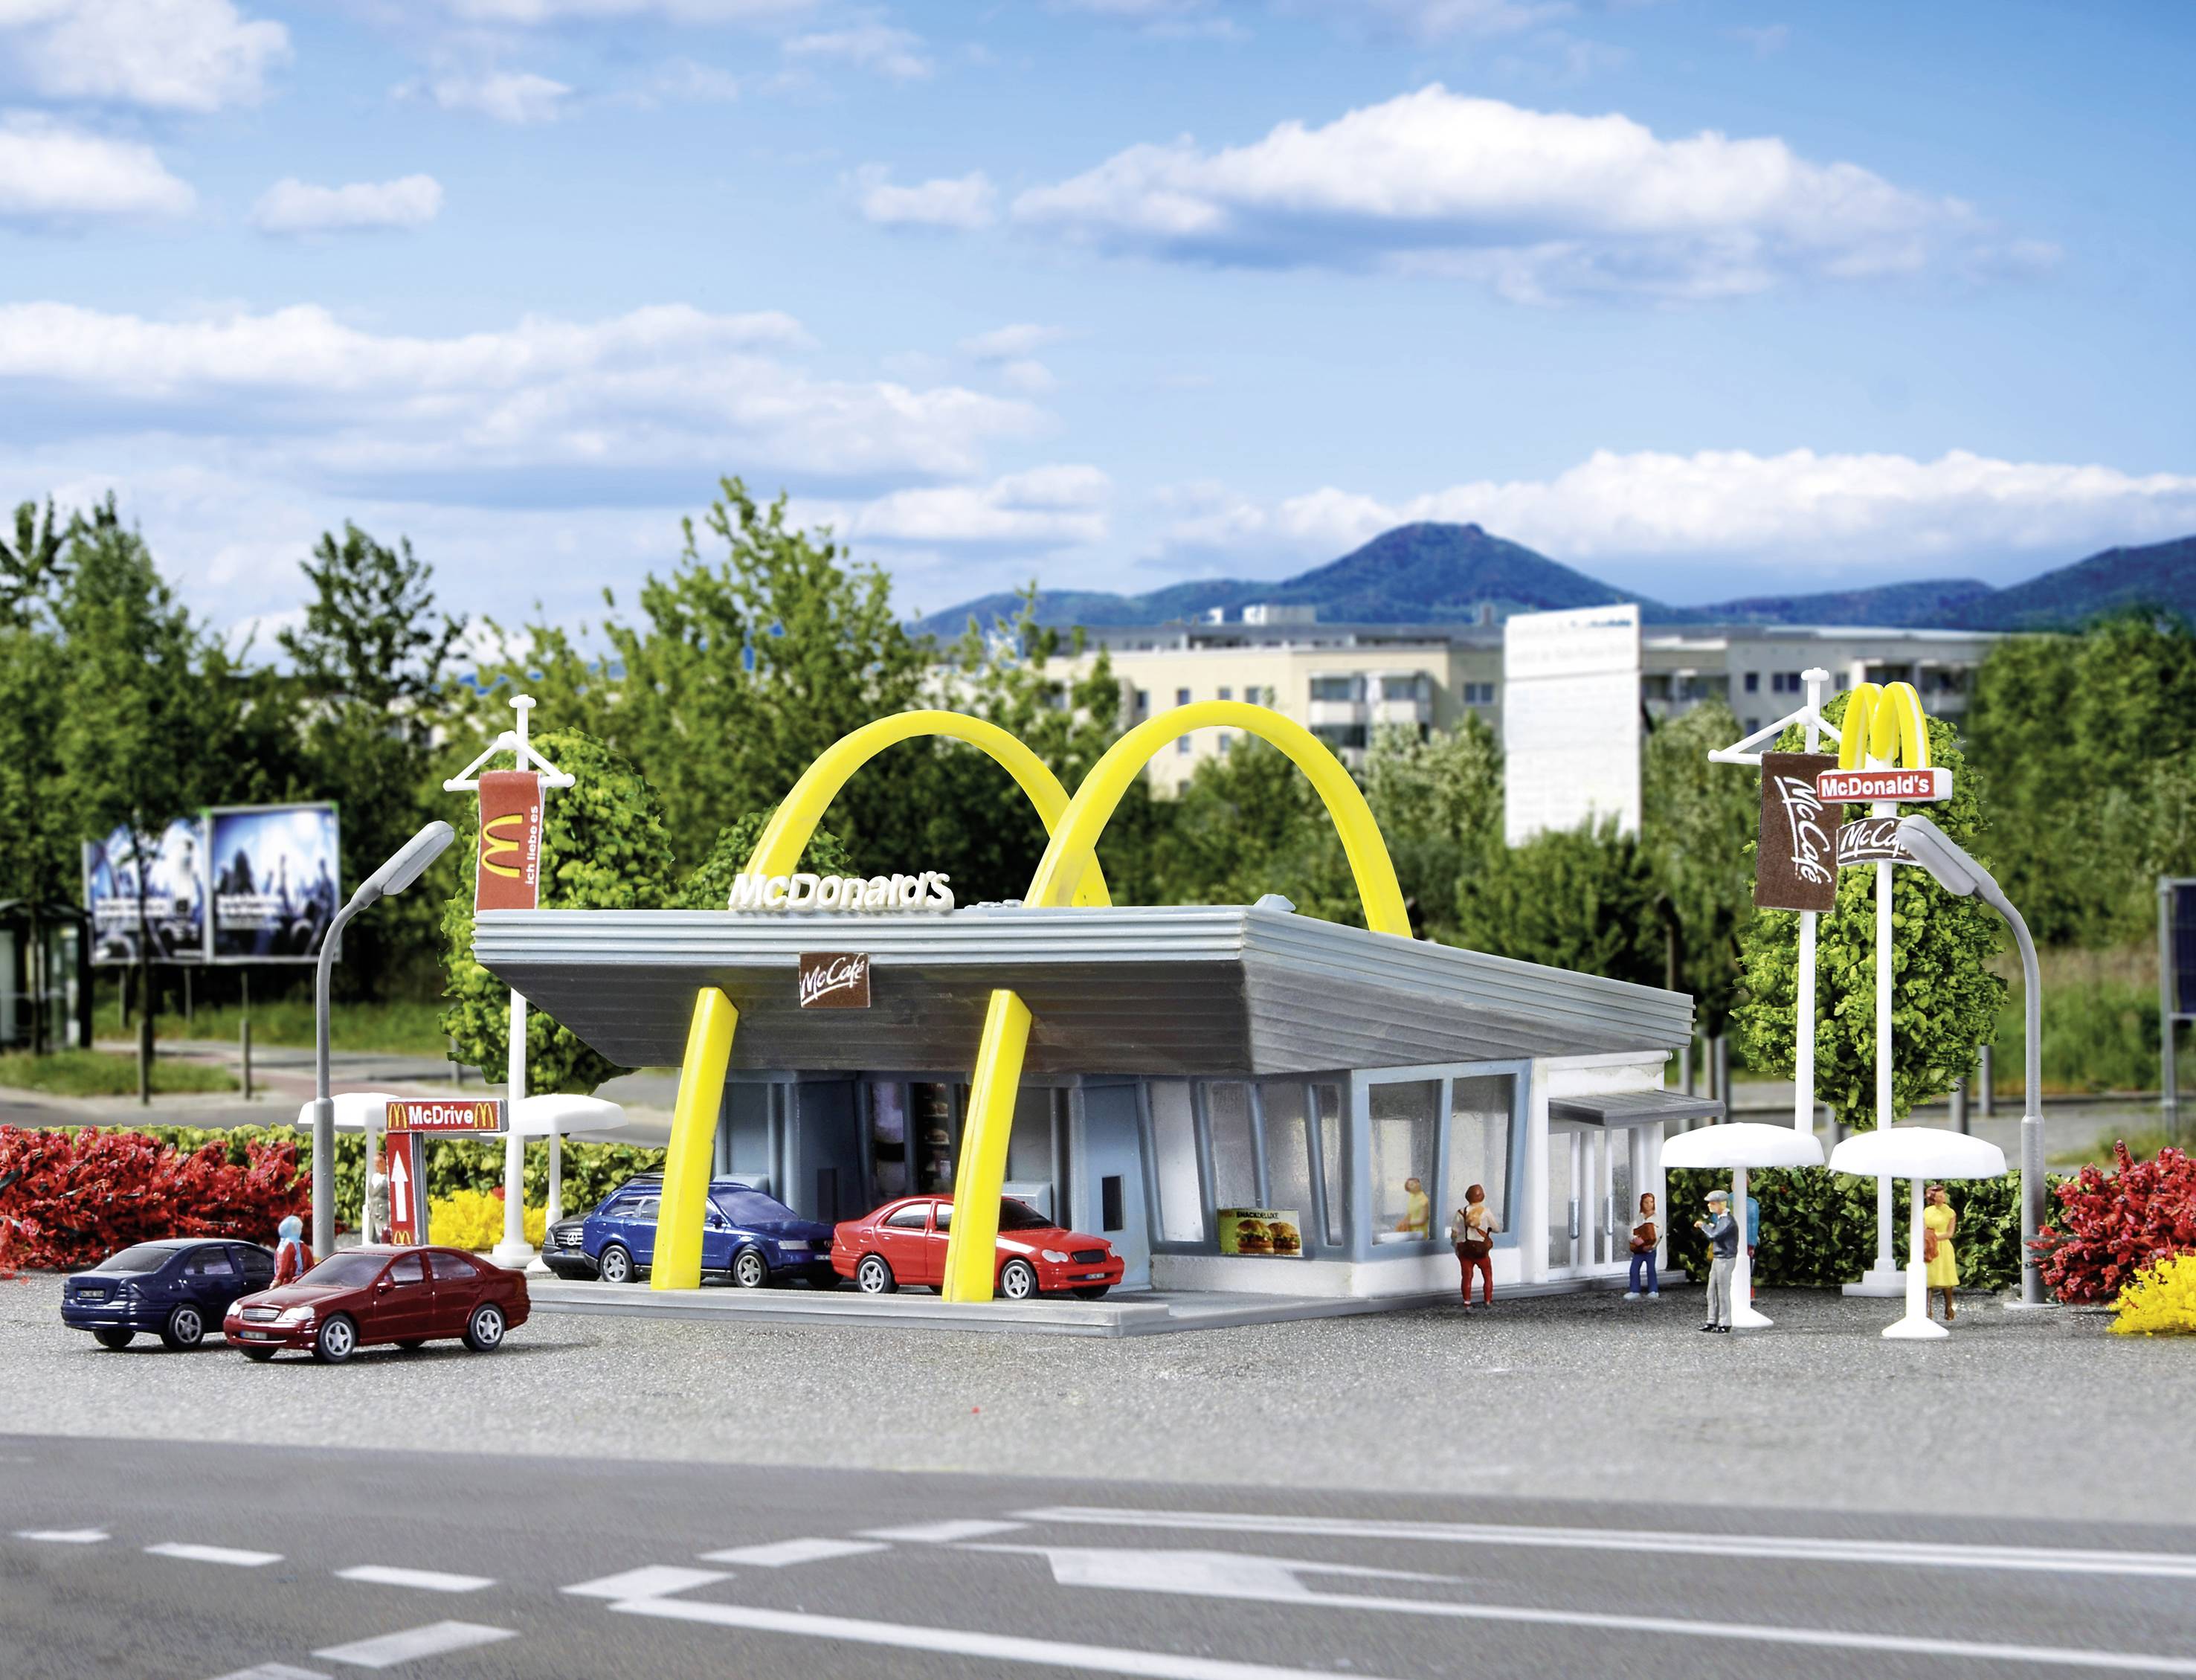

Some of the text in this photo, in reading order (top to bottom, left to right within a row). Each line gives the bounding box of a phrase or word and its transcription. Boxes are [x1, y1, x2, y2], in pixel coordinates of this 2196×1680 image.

[1820, 776, 1930, 798] McDonald's
[525, 805, 538, 885] ich liebe es
[1776, 776, 1832, 884] McCafé
[1840, 820, 1907, 857] McCa
[727, 870, 955, 912] McDonald's
[800, 953, 866, 1001] McCafé
[409, 1106, 474, 1124] McDrive
